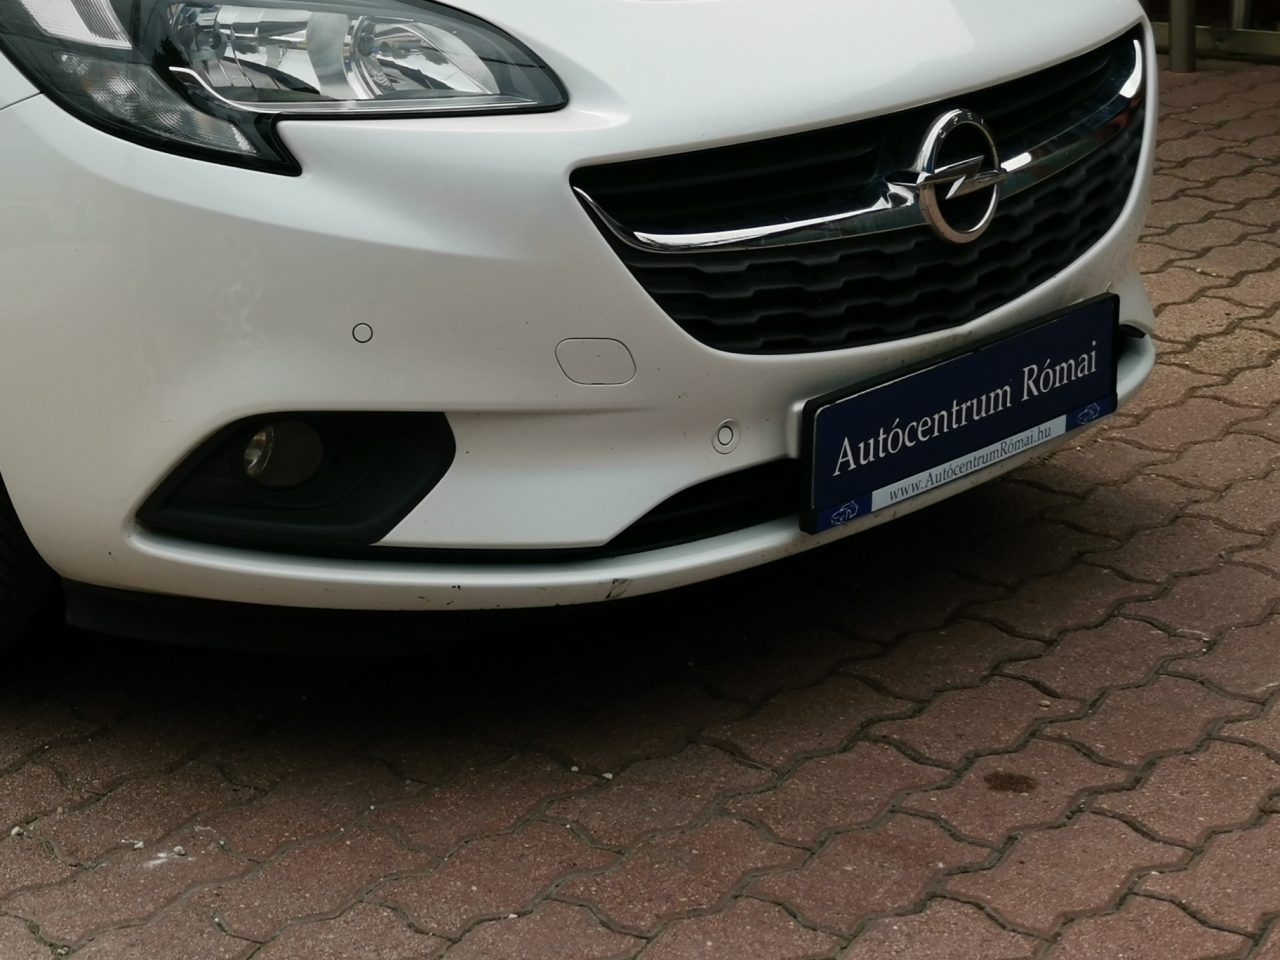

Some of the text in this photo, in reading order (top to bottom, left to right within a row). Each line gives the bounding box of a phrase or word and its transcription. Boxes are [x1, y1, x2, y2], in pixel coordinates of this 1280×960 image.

[832, 341, 1098, 476] Autócentrum Római
[889, 424, 1051, 502] www.AutócentrumRómai.hu
